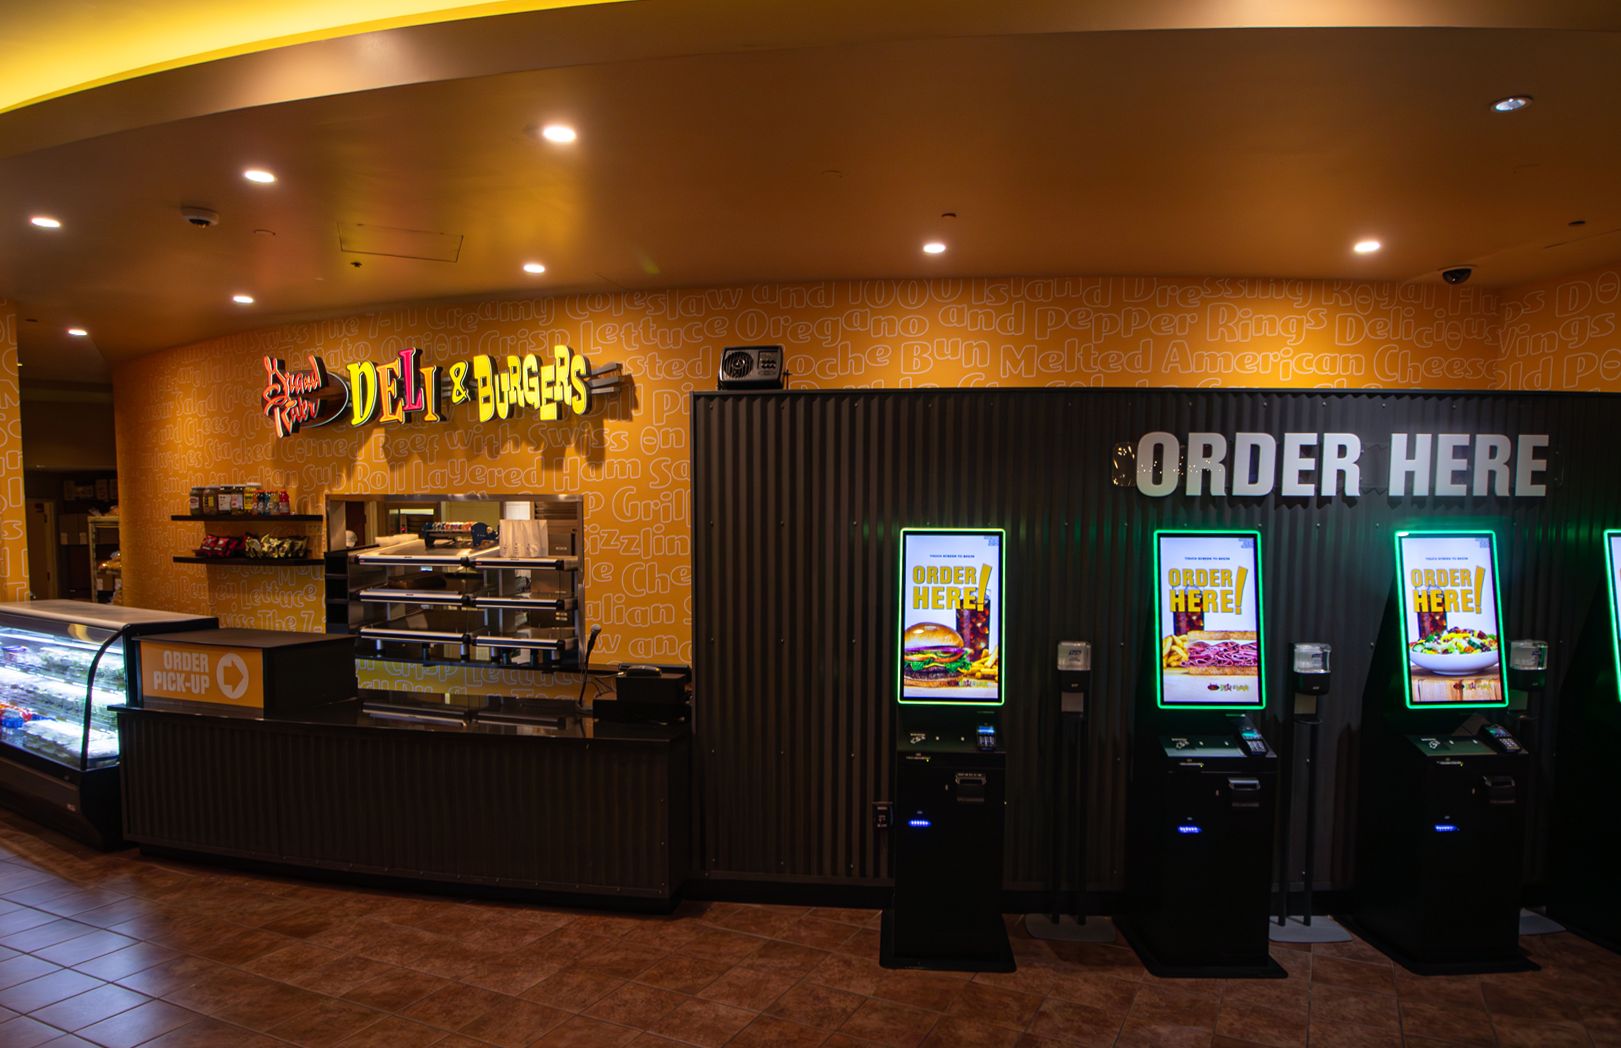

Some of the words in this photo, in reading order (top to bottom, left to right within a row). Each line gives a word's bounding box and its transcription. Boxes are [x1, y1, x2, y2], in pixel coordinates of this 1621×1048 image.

[425, 297, 555, 333] Creamy
[752, 282, 836, 310] and
[479, 328, 570, 362] Crisp
[580, 316, 730, 356] Lettuce
[735, 308, 930, 348] Oregano
[938, 301, 1025, 336] and
[1035, 306, 1198, 343] Pepper
[1207, 302, 1327, 345] Rings
[176, 386, 218, 418] Salad
[901, 338, 990, 374] Bun
[1001, 337, 1153, 378] Melted
[1161, 340, 1365, 381] American
[347, 347, 441, 427] DELI
[448, 361, 471, 405] &
[473, 345, 589, 422] BURGERS
[184, 417, 241, 448] Cheese
[205, 433, 277, 469] Stacked
[281, 431, 365, 463] Corned
[372, 434, 440, 465] Beef
[444, 423, 522, 461] with
[528, 421, 630, 458] Swiss
[302, 463, 346, 491] Sub
[351, 460, 406, 494] Roll
[412, 456, 545, 494] Layered
[553, 457, 642, 492] Ham
[1135, 431, 1362, 497] ORDER
[1388, 431, 1550, 497] HERE
[912, 565, 977, 585] ORDER
[1168, 568, 1233, 588] ORDER
[1410, 568, 1472, 588] ORDER
[240, 580, 318, 610] Lettuce
[257, 609, 297, 632] The
[163, 650, 210, 673] ORDER
[153, 670, 211, 695] PICK-UP
